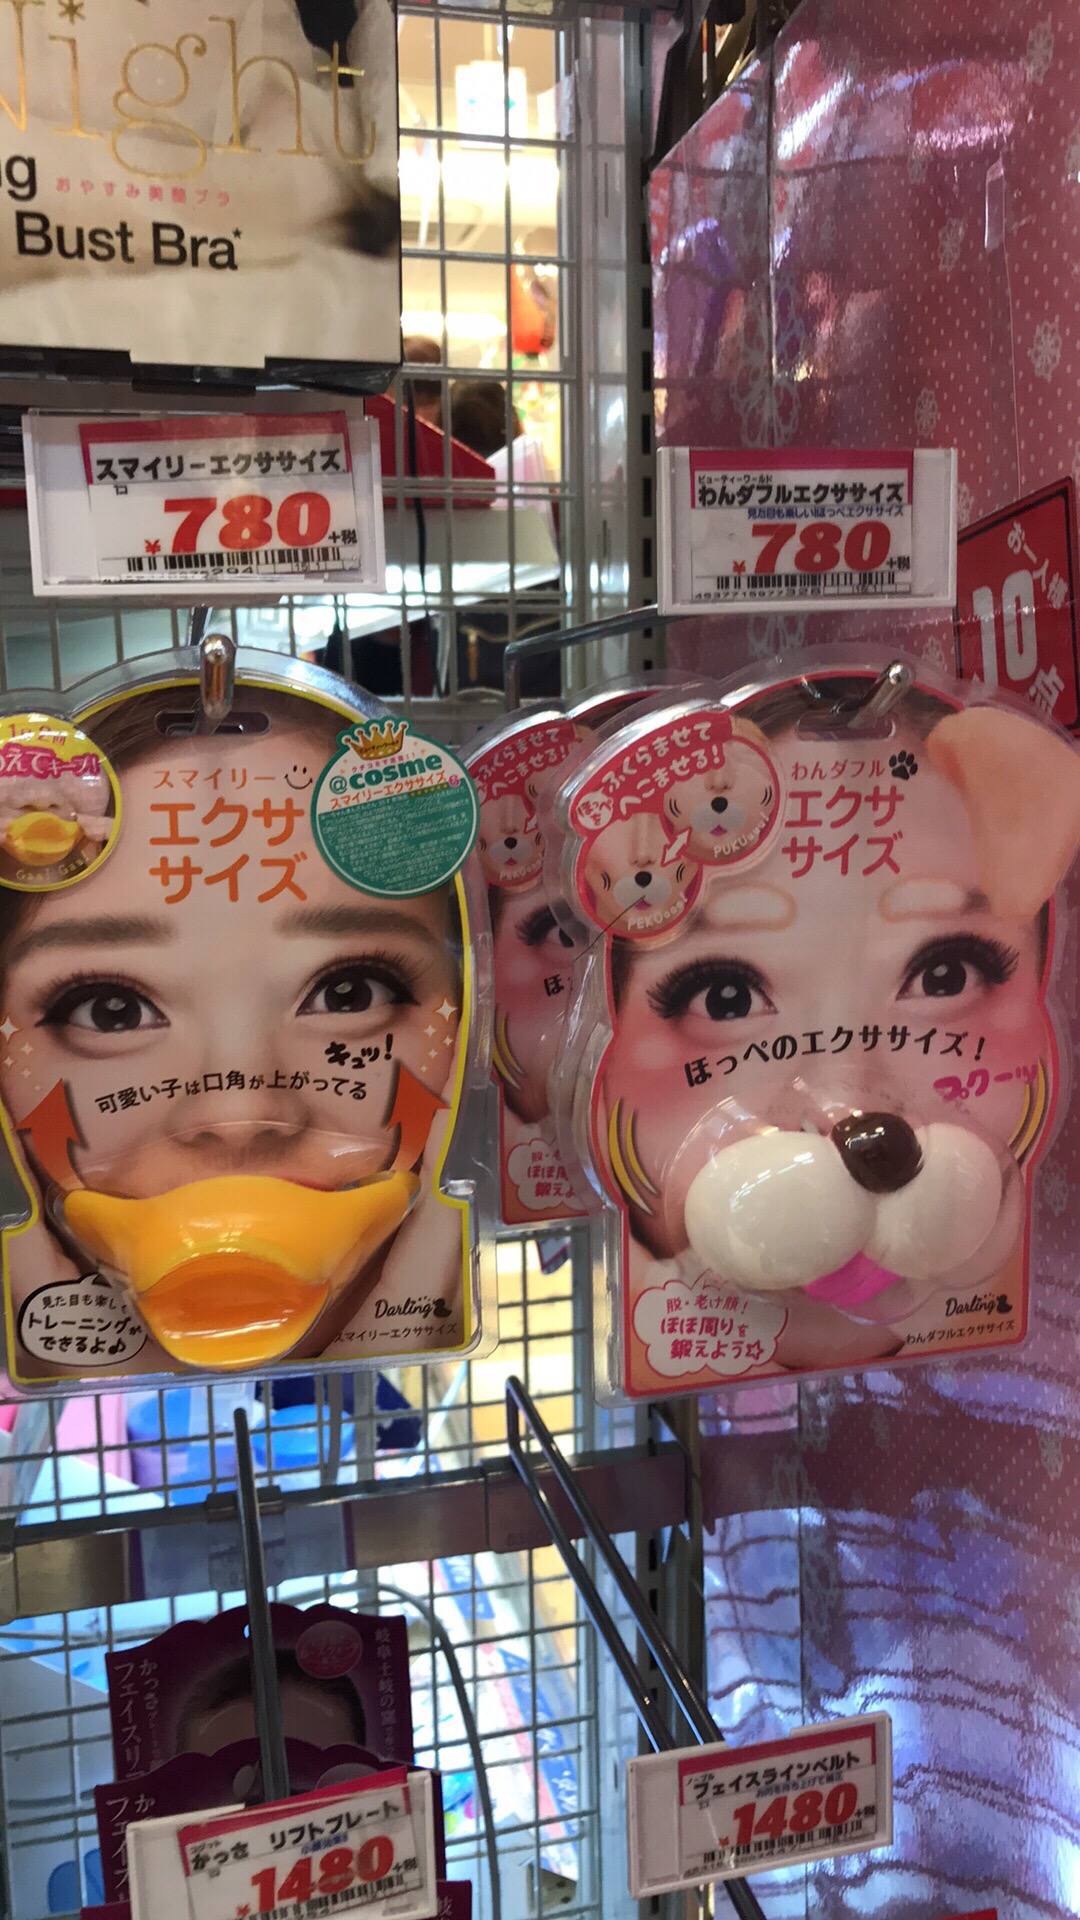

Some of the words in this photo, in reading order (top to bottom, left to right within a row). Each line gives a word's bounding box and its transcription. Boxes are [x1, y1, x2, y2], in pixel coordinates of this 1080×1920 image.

[15, 211, 135, 264] Bust
[96, 448, 341, 482] スマイリーエクササイズ
[698, 482, 905, 507] わんダフルエクササイズ
[972, 569, 1038, 697] 10
[153, 768, 277, 790] スマイリー
[329, 754, 443, 795] @cosme
[601, 721, 713, 794] ふくらませて
[791, 758, 886, 781] わんダフル
[329, 769, 447, 810] スマイリーエクササイズ
[784, 784, 905, 830] エクサ
[150, 797, 305, 848] エクサ
[781, 830, 904, 879] サイズ
[149, 852, 307, 905] サイズ
[94, 1069, 368, 1114] 可愛い子は口角が上がってる
[374, 1296, 433, 1319] Darling
[945, 1294, 996, 1317] Darling
[693, 1750, 861, 1801] フェイスラインベルト
